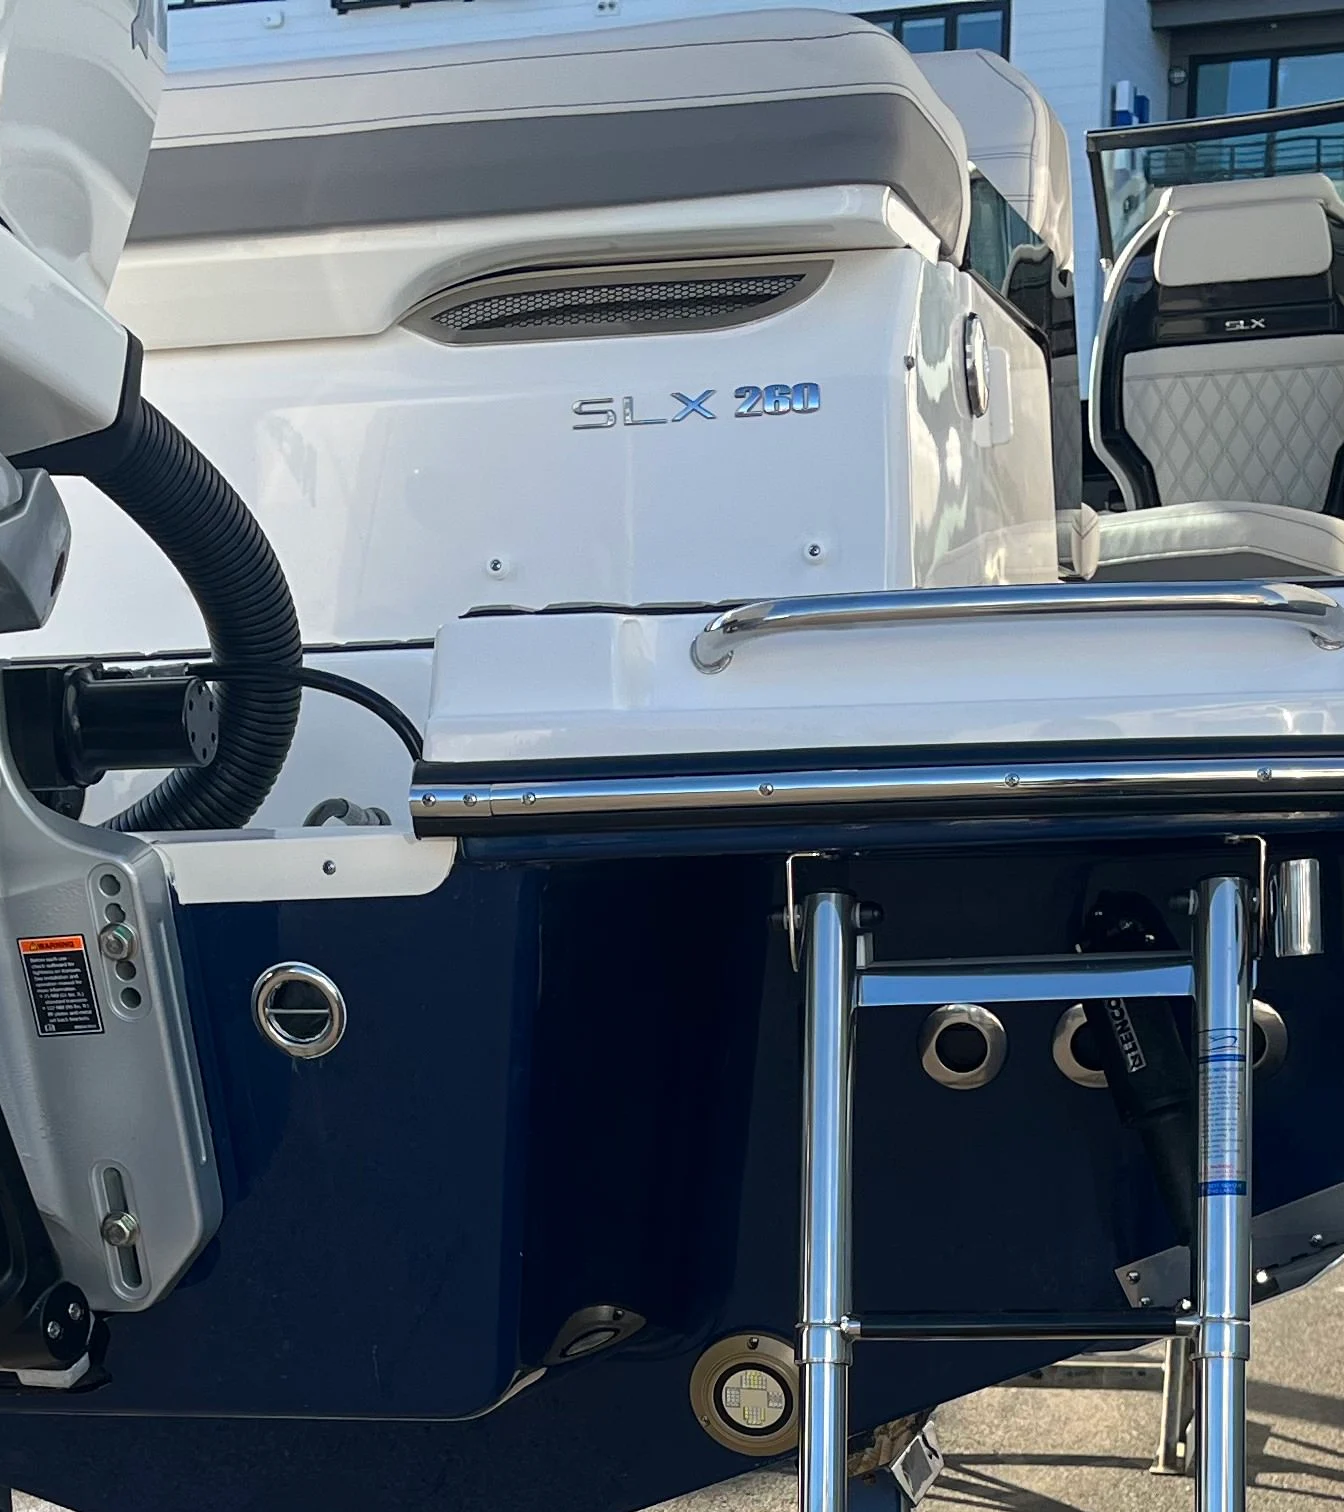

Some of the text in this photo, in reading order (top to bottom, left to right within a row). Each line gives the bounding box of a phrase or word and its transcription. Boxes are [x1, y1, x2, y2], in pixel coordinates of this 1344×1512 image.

[1225, 318, 1266, 331] SLX
[572, 382, 821, 430] SLX 260
[1108, 998, 1138, 1055] LENCO
